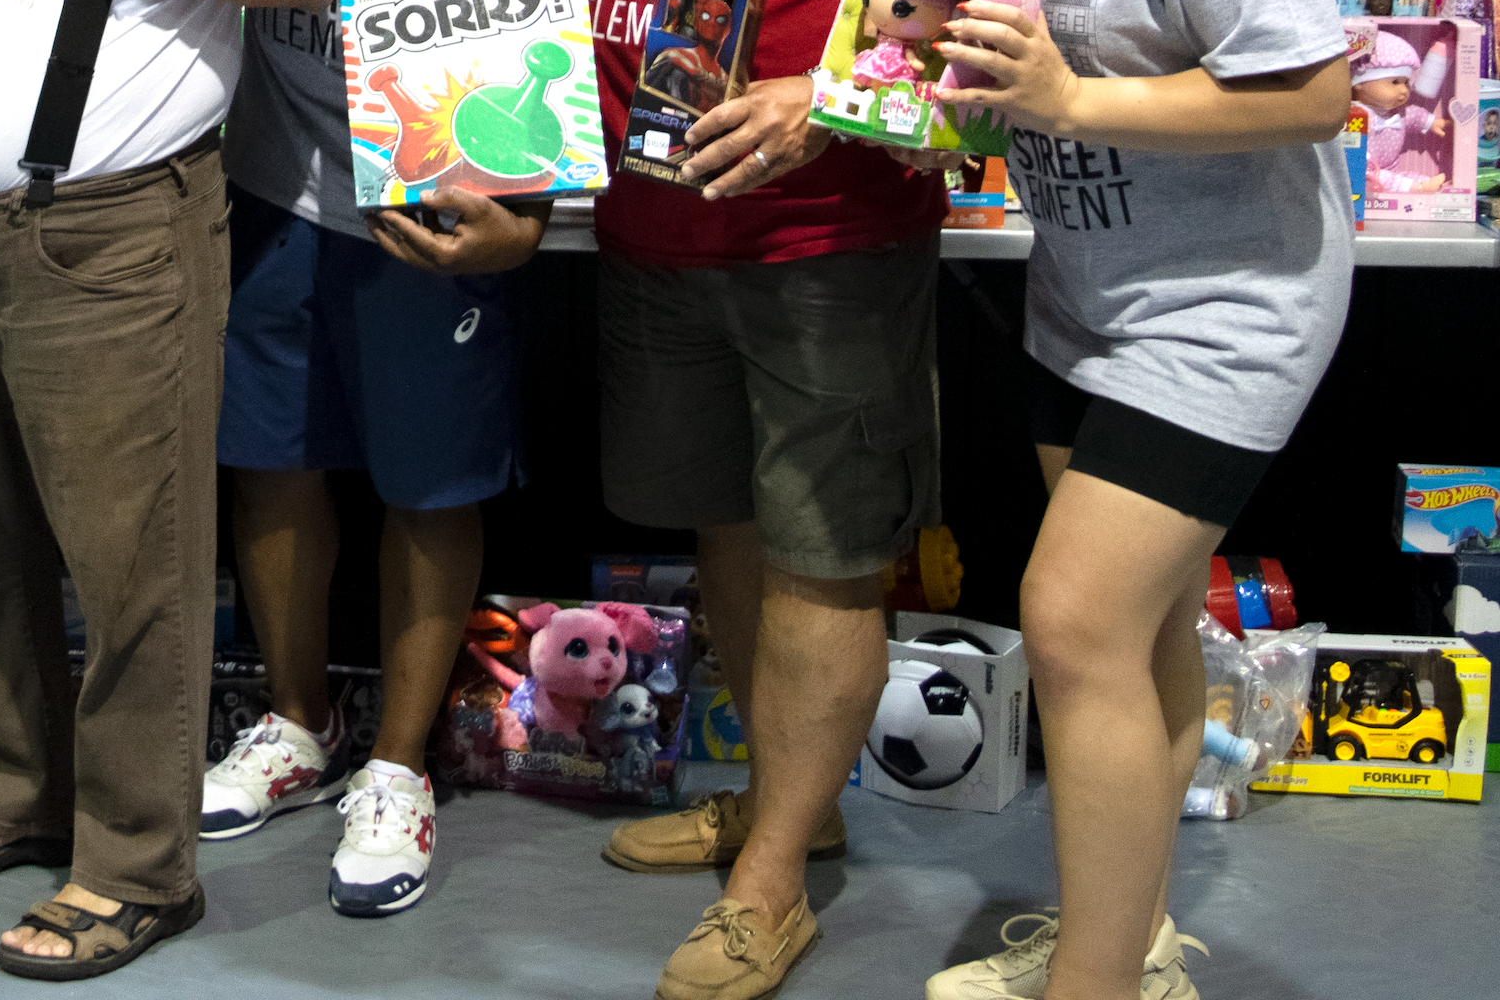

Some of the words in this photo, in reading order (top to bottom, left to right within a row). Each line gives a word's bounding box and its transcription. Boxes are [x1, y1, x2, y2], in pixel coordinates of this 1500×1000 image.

[632, 107, 694, 131] SPIDER-M
[624, 155, 651, 174] TITAN
[650, 163, 675, 182] HERO
[1009, 173, 1132, 231] LEMENT
[1420, 491, 1451, 509] HOT
[1363, 772, 1431, 784] FORKLIFT
